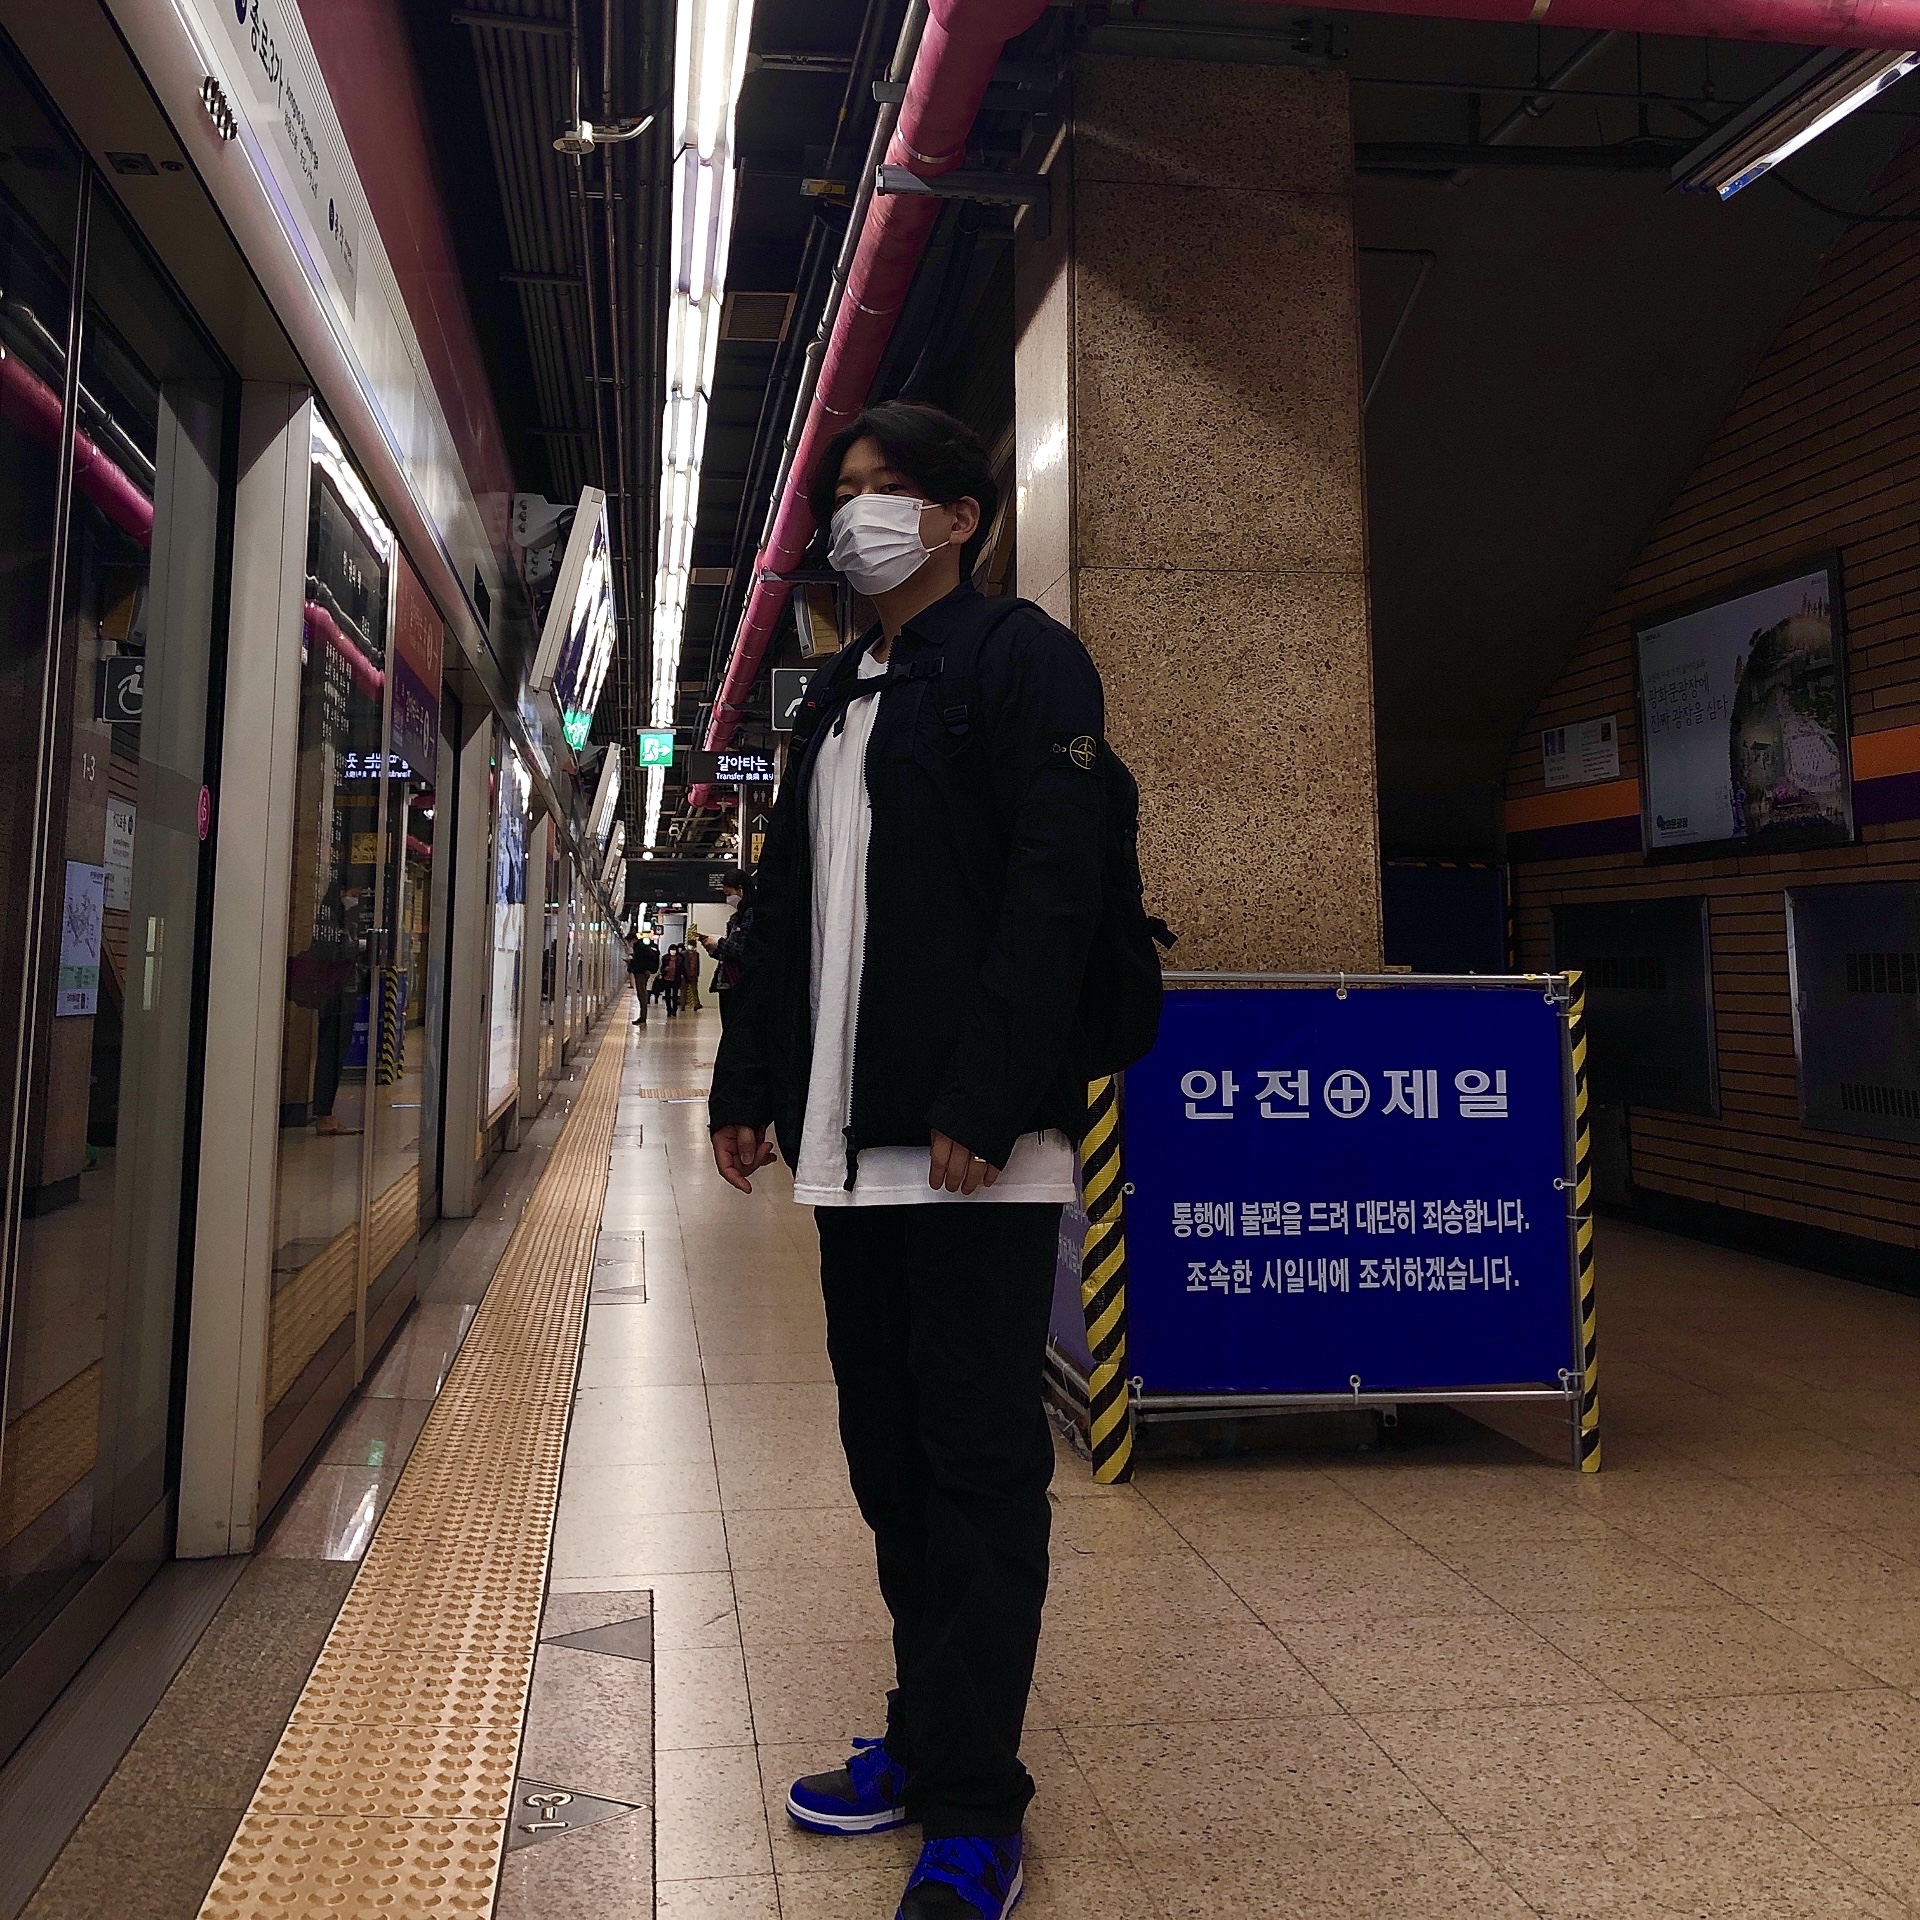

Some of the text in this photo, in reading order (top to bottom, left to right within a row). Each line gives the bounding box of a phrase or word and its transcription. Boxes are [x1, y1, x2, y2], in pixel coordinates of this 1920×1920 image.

[1647, 671, 1710, 709] 광화문광장에
[1650, 693, 1729, 734] 진짜 광장을 심다
[83, 752, 96, 781] 1-3
[715, 772, 744, 780] Transfer
[717, 755, 768, 771] 갈아타는
[753, 844, 759, 852] 4
[1171, 1198, 1530, 1238] 통행에 불편을 드려 대단히 죄송합니다.
[1186, 1255, 1520, 1295] 조속한 시일내에 조치하겠습니다.
[518, 1792, 574, 1834] 1-3
